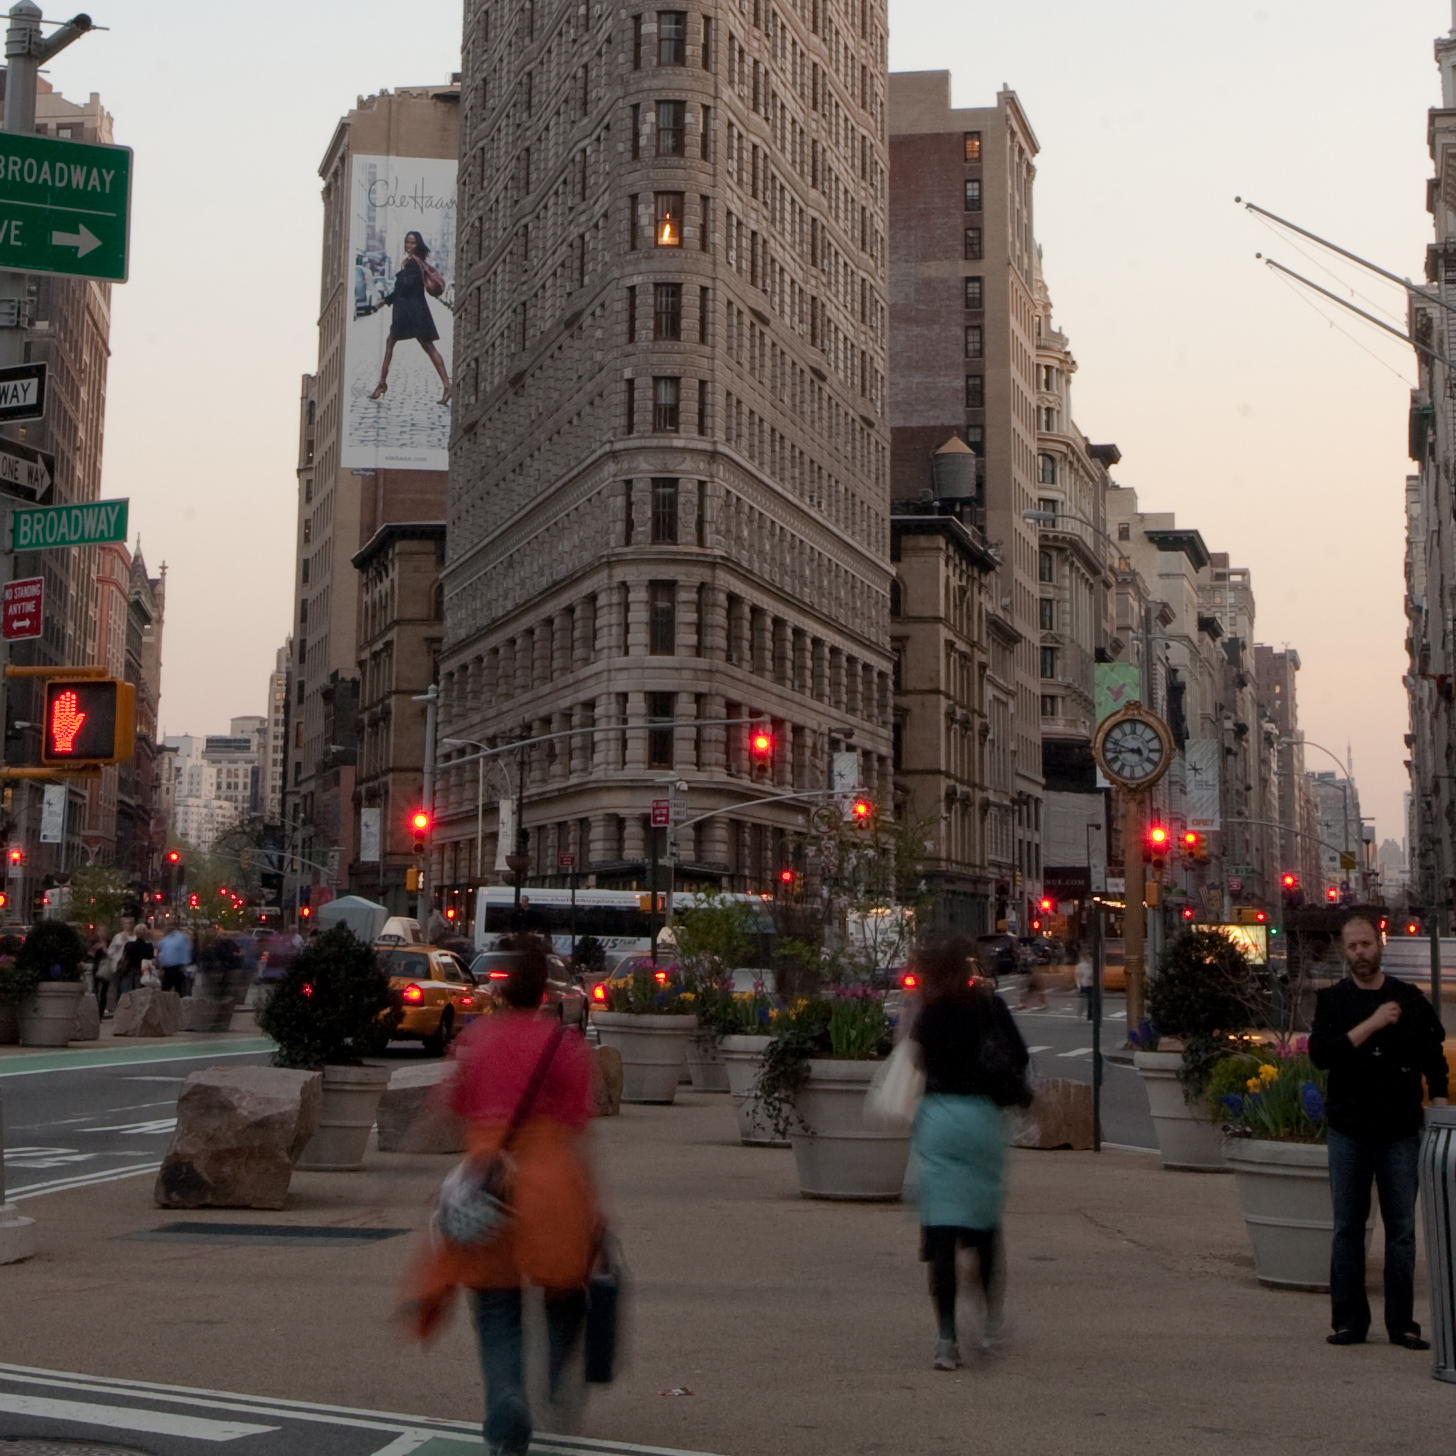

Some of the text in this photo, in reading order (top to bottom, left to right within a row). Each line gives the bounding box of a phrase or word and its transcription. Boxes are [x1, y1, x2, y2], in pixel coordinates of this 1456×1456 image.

[368, 176, 409, 208] Cole
[1, 455, 46, 493] ONE WAY
[18, 505, 120, 546] BROADWAY
[5, 583, 41, 601] NO STANDING
[8, 601, 36, 616] ANYTIME
[1191, 818, 1215, 827] GREY
